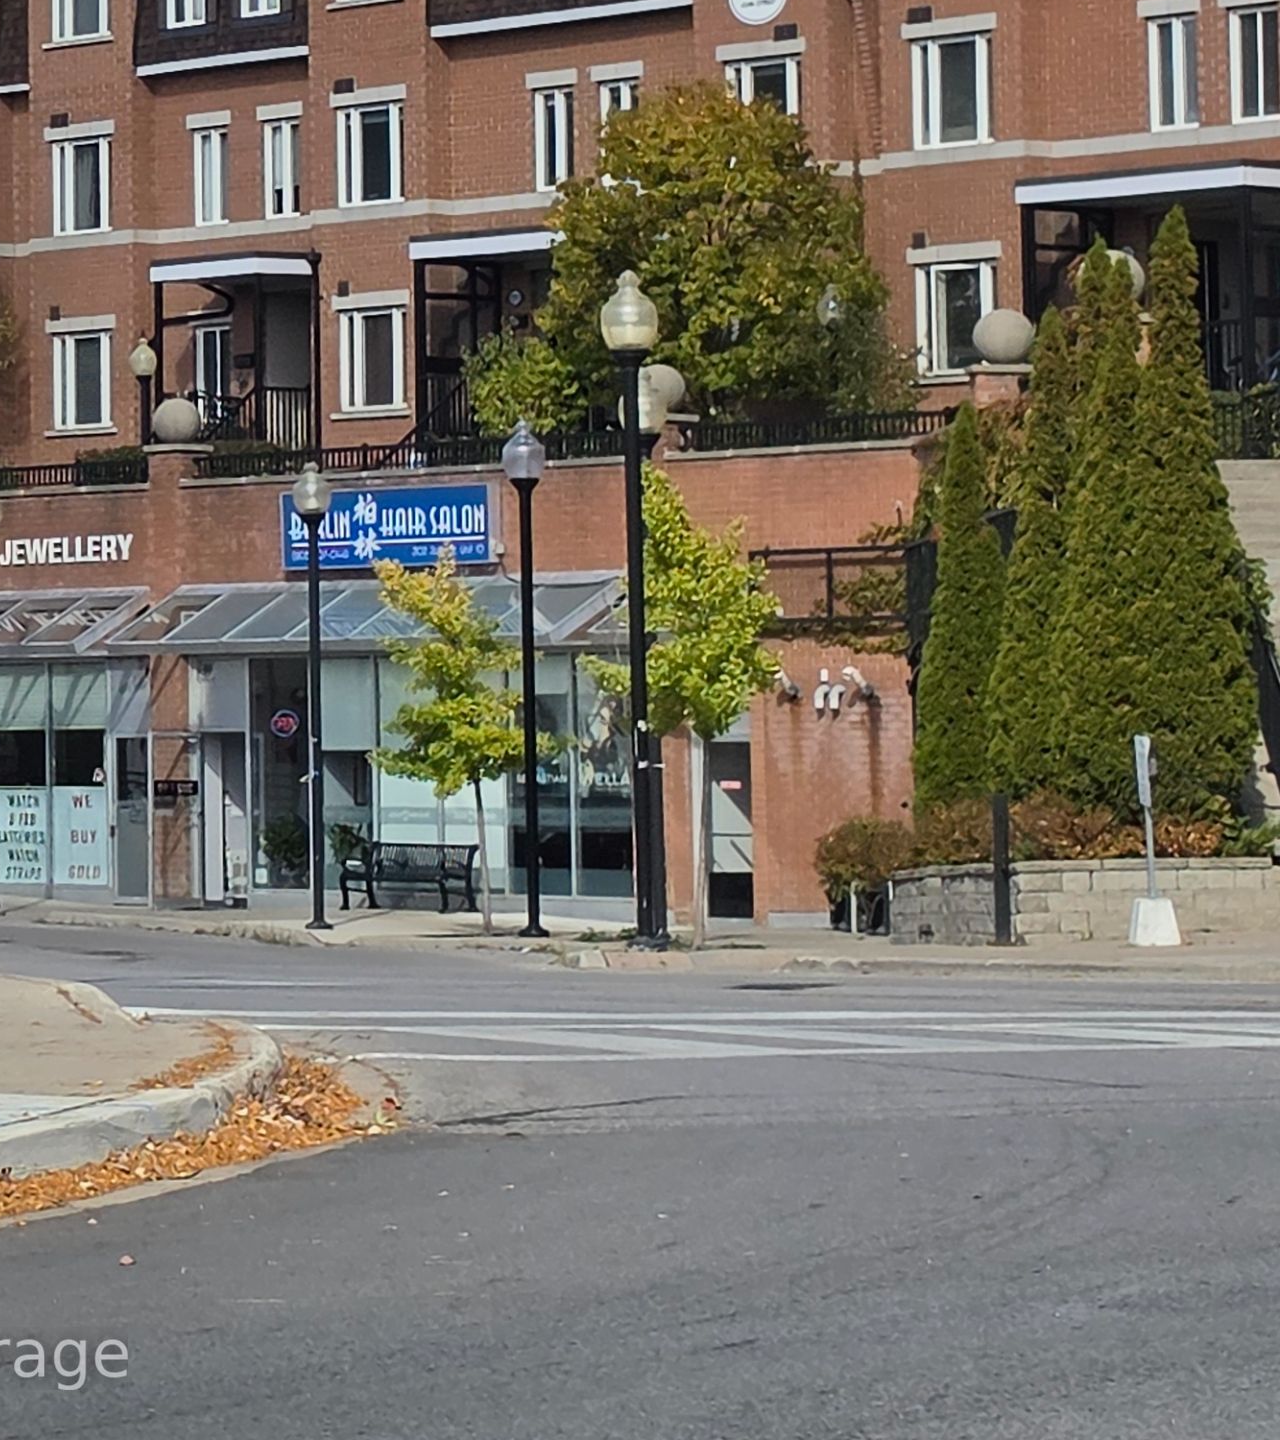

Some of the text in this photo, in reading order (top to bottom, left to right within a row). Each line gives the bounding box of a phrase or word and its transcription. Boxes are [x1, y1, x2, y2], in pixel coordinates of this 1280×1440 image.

[288, 504, 486, 541] BLIN HAIR SALON
[353, 493, 382, 560] 柏林
[72, 794, 93, 809] WE
[70, 830, 97, 844] BUY
[68, 865, 101, 880] GOLD
